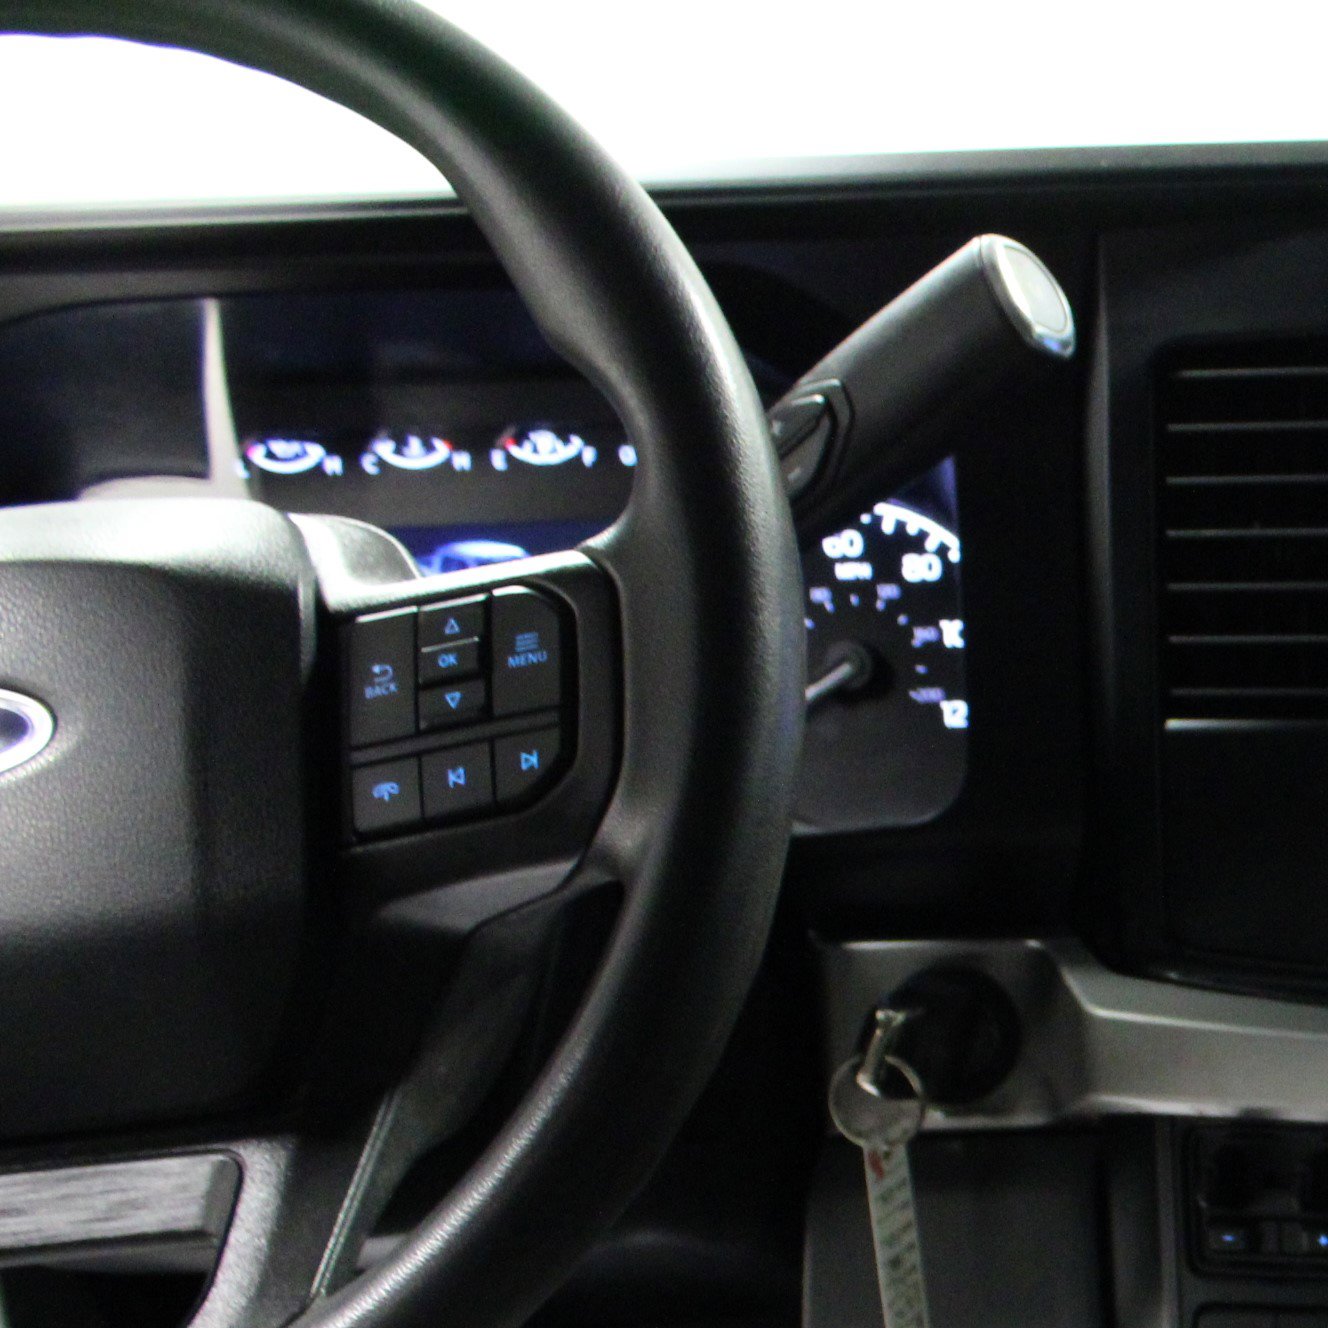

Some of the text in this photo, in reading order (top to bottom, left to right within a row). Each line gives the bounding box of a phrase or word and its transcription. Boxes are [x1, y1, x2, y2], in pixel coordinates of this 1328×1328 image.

[822, 528, 865, 559] 60
[902, 552, 943, 583] 80
[437, 653, 459, 668] OK
[507, 651, 548, 668] MENU
[364, 683, 398, 700] BACK
[939, 699, 970, 730] 12
